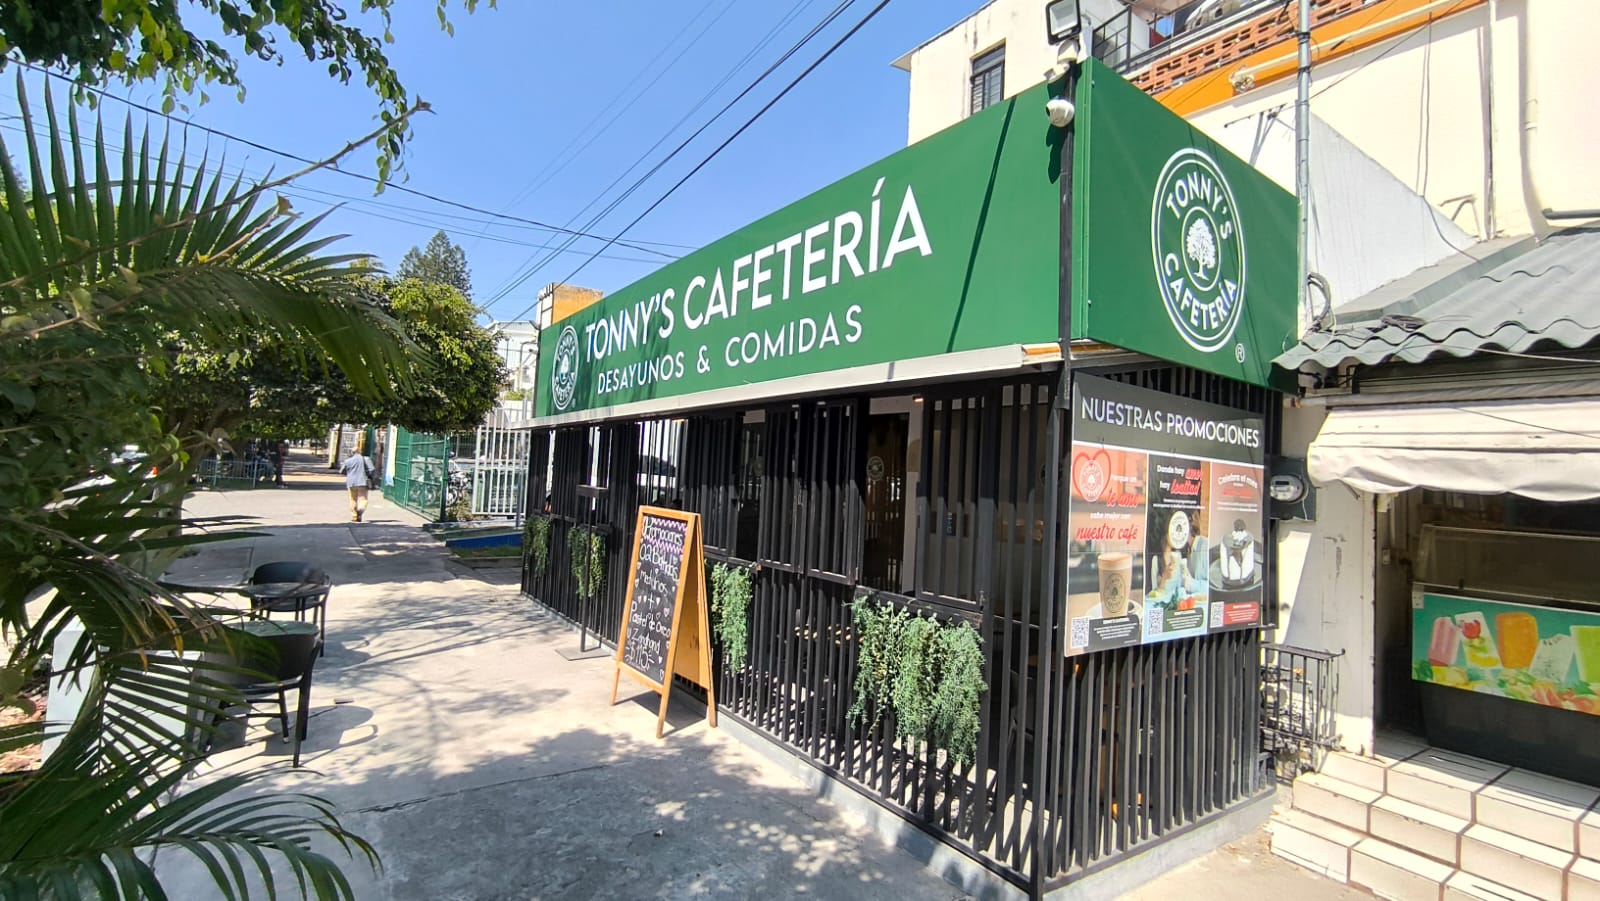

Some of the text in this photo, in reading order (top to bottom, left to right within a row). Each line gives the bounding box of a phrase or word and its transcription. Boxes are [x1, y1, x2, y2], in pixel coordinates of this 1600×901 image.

[1166, 171, 1233, 240] TONNY'S
[585, 176, 932, 363] TONNY'S CAFETERÍA
[1164, 252, 1237, 330] CAFETERÍA
[598, 304, 862, 394] DESAYUNOS & COMIDAS
[1081, 397, 1260, 448] NUESTRAS PROMOCIONES
[1159, 480, 1171, 492] hay
[1174, 466, 1185, 477] hay
[1076, 522, 1116, 541] nuestro
